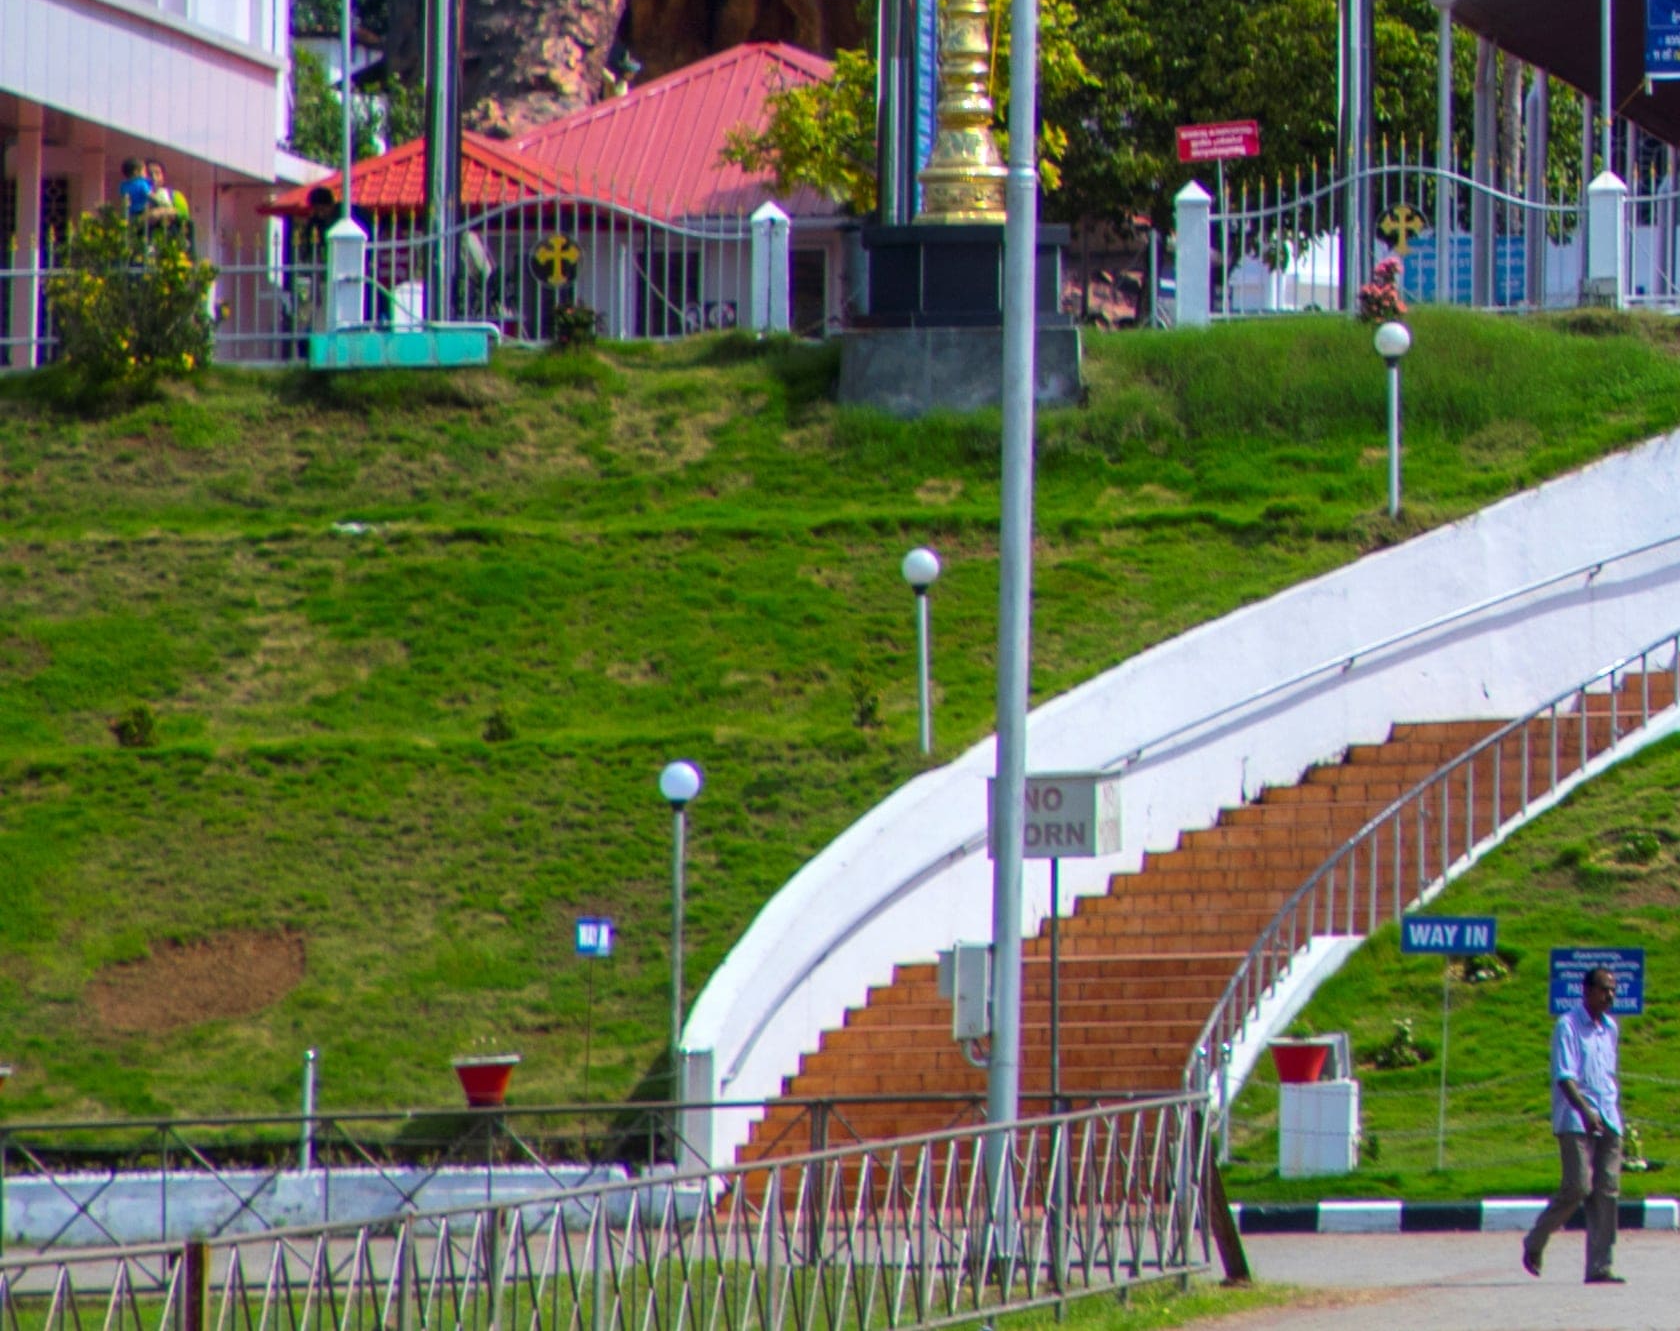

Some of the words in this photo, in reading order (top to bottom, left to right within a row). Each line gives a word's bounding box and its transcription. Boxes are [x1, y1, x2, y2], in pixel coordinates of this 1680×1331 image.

[1024, 786, 1063, 813] NO
[1024, 822, 1085, 847] ORN
[1408, 923, 1459, 947] WAY
[1464, 924, 1489, 947] IN
